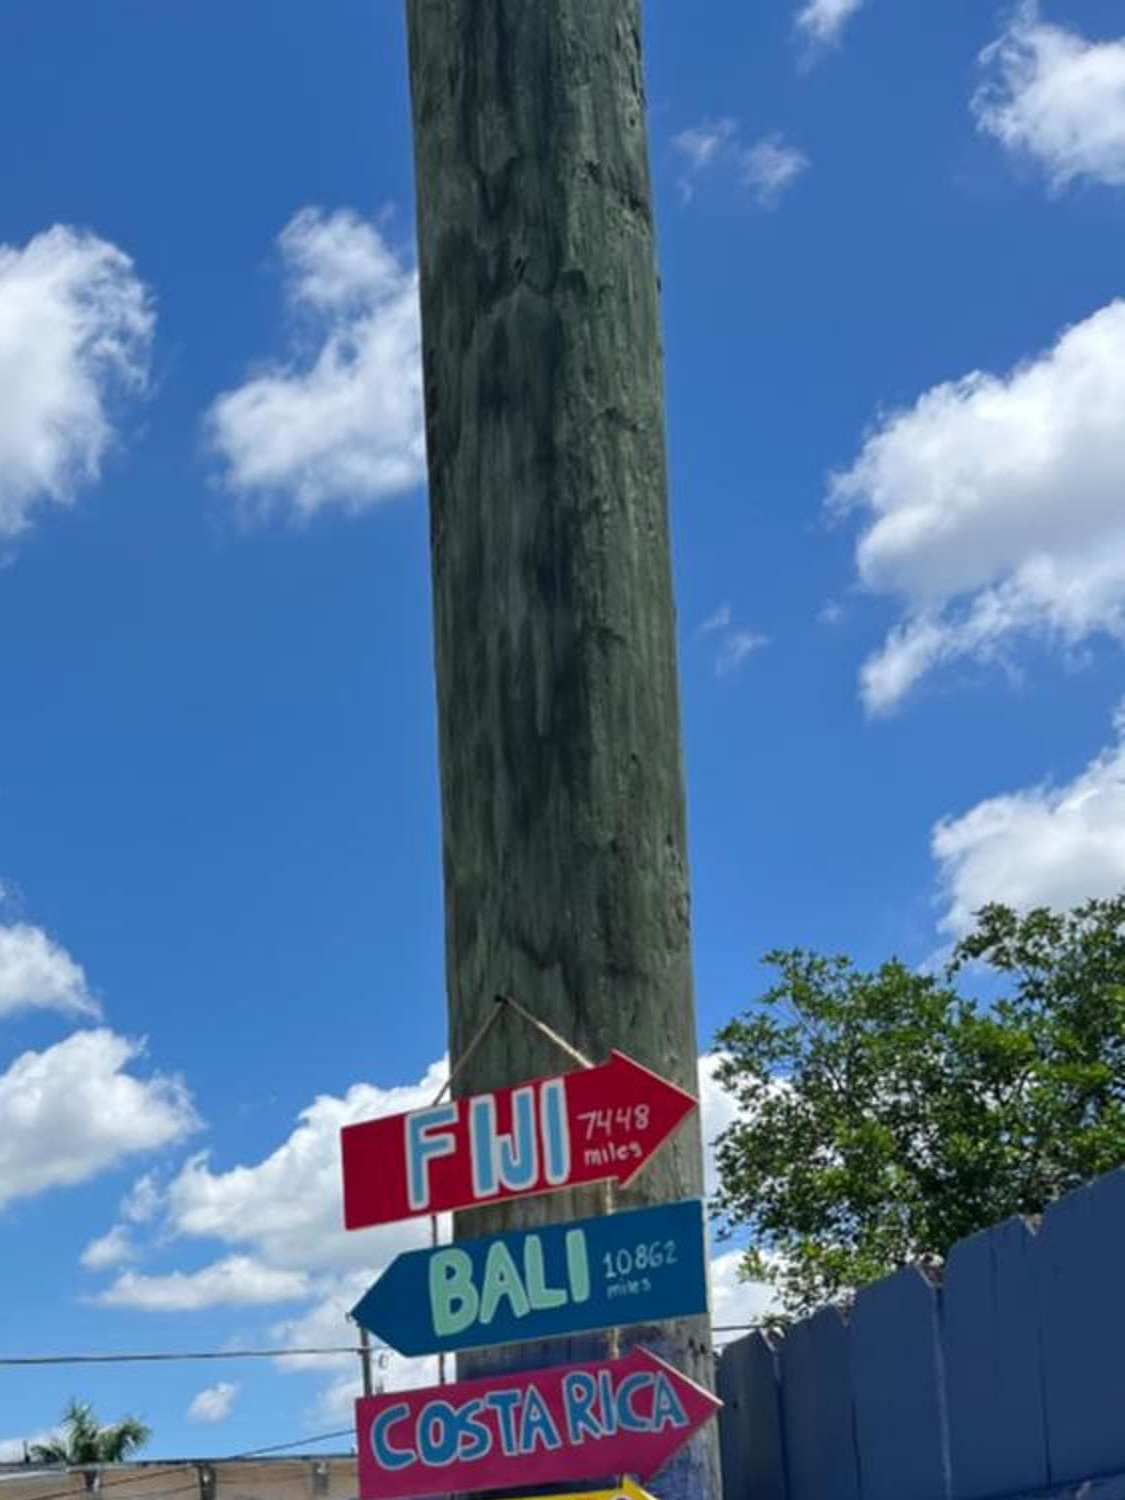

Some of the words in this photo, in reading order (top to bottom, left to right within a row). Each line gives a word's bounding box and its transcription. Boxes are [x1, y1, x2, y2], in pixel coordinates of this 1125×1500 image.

[404, 1076, 571, 1211] FIJI
[577, 1104, 651, 1141] 7448
[584, 1141, 643, 1167] miles
[429, 1228, 591, 1337] BALI
[603, 1240, 678, 1279] 10862
[370, 1384, 559, 1470] COSTA
[563, 1370, 689, 1445] RICA
